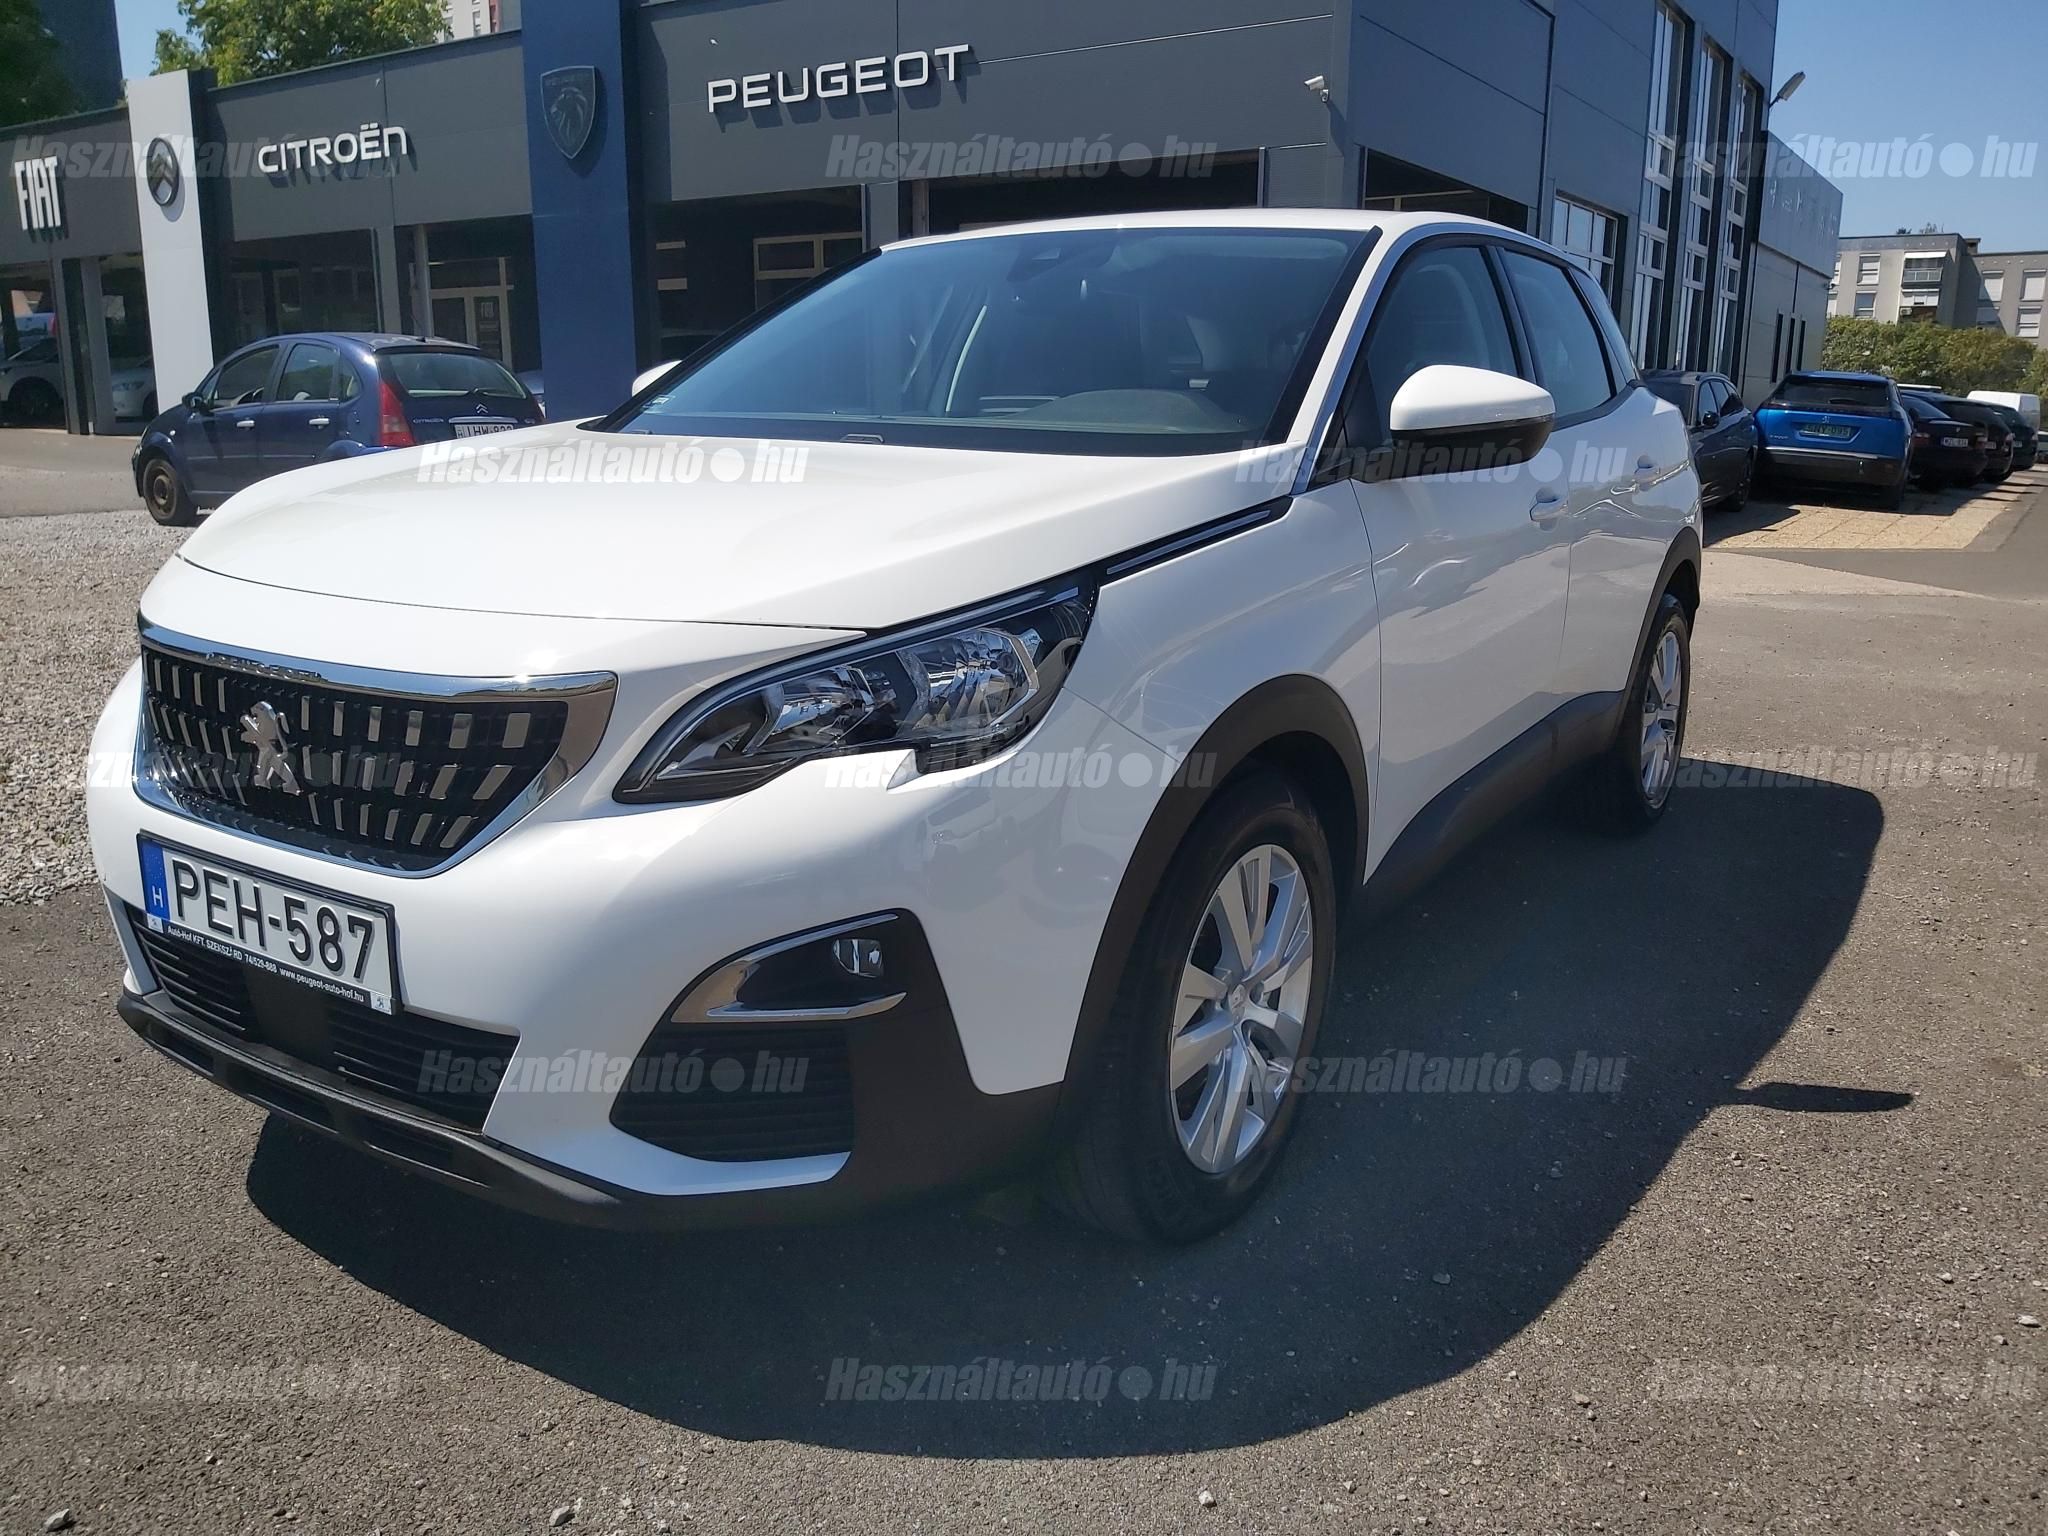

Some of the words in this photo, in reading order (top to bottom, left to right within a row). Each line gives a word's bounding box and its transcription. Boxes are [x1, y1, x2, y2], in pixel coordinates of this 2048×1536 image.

[707, 44, 969, 113] PEUGEOT
[15, 155, 62, 230] FIAT
[152, 887, 164, 909] H
[172, 858, 374, 979] PEH-587
[280, 967, 365, 1003] www.peugeot-auto-hof.hu
